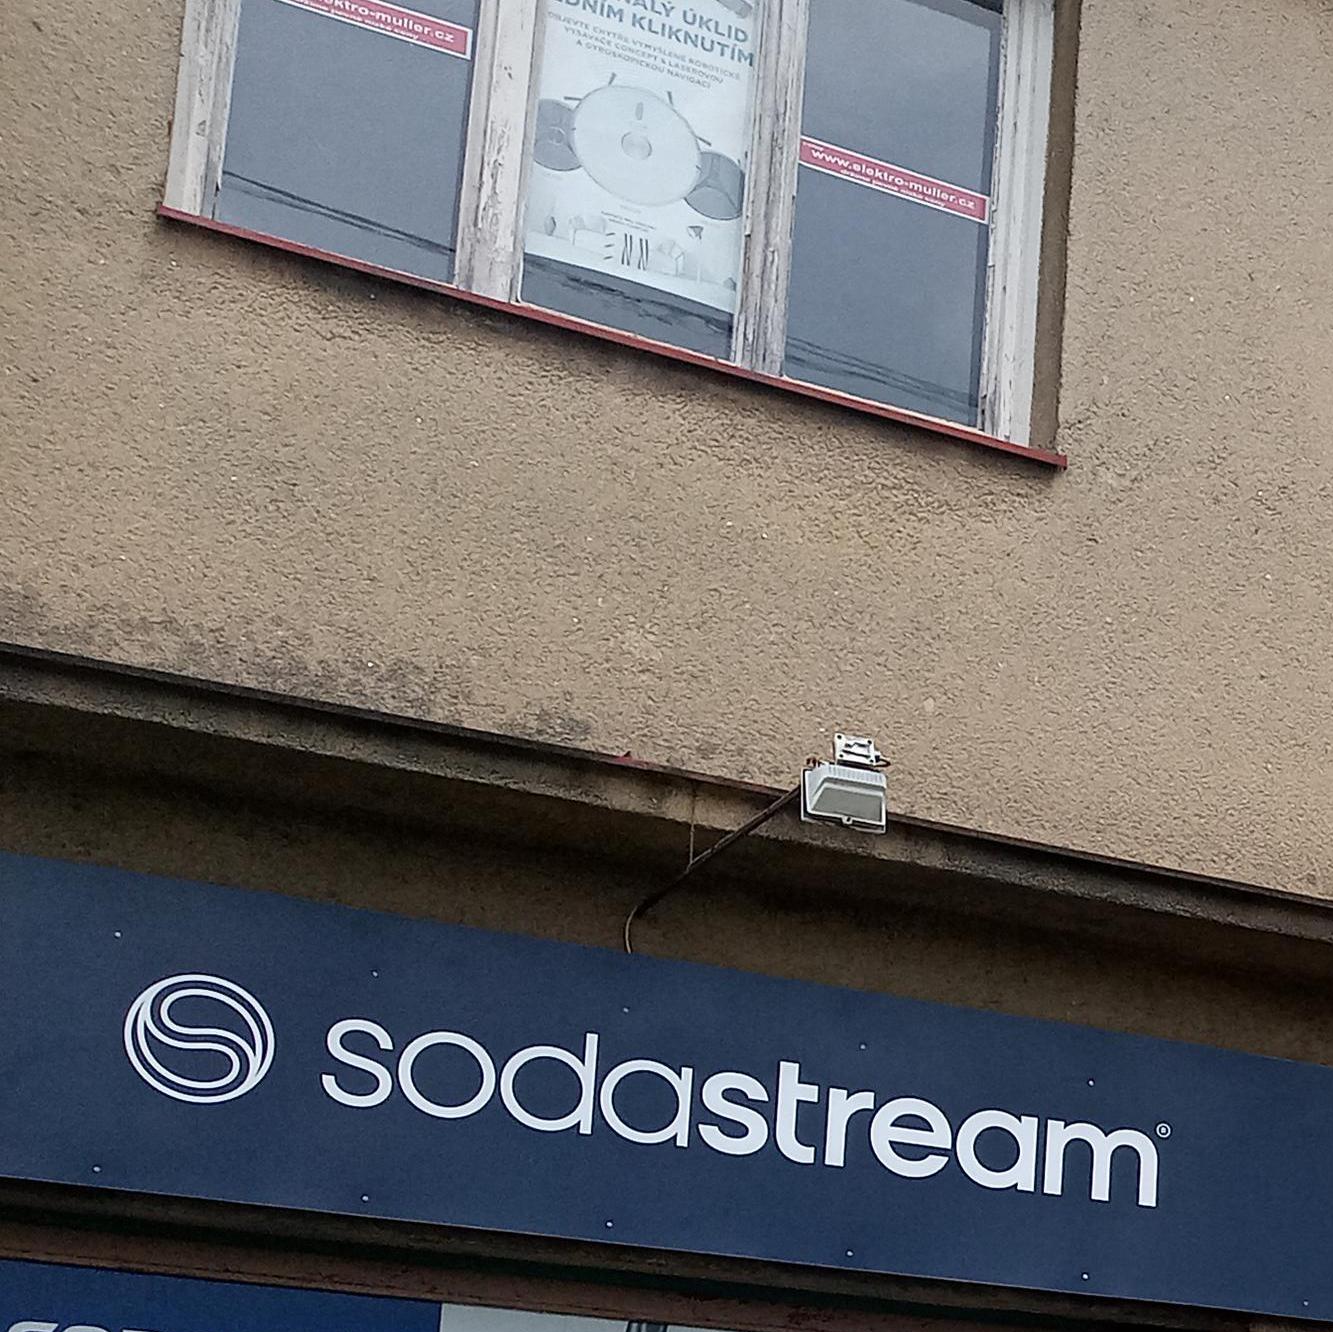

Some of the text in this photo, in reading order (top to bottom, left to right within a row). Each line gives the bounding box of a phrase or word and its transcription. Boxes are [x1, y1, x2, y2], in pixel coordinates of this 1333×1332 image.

[322, 0, 455, 43] ktro-muller.cz
[632, 13, 754, 67] KLIKNUTÍM
[683, 8, 749, 43] ÚKLID
[811, 149, 977, 210] www.elektro-muller.cz
[321, 1018, 1160, 1208] sodastream
